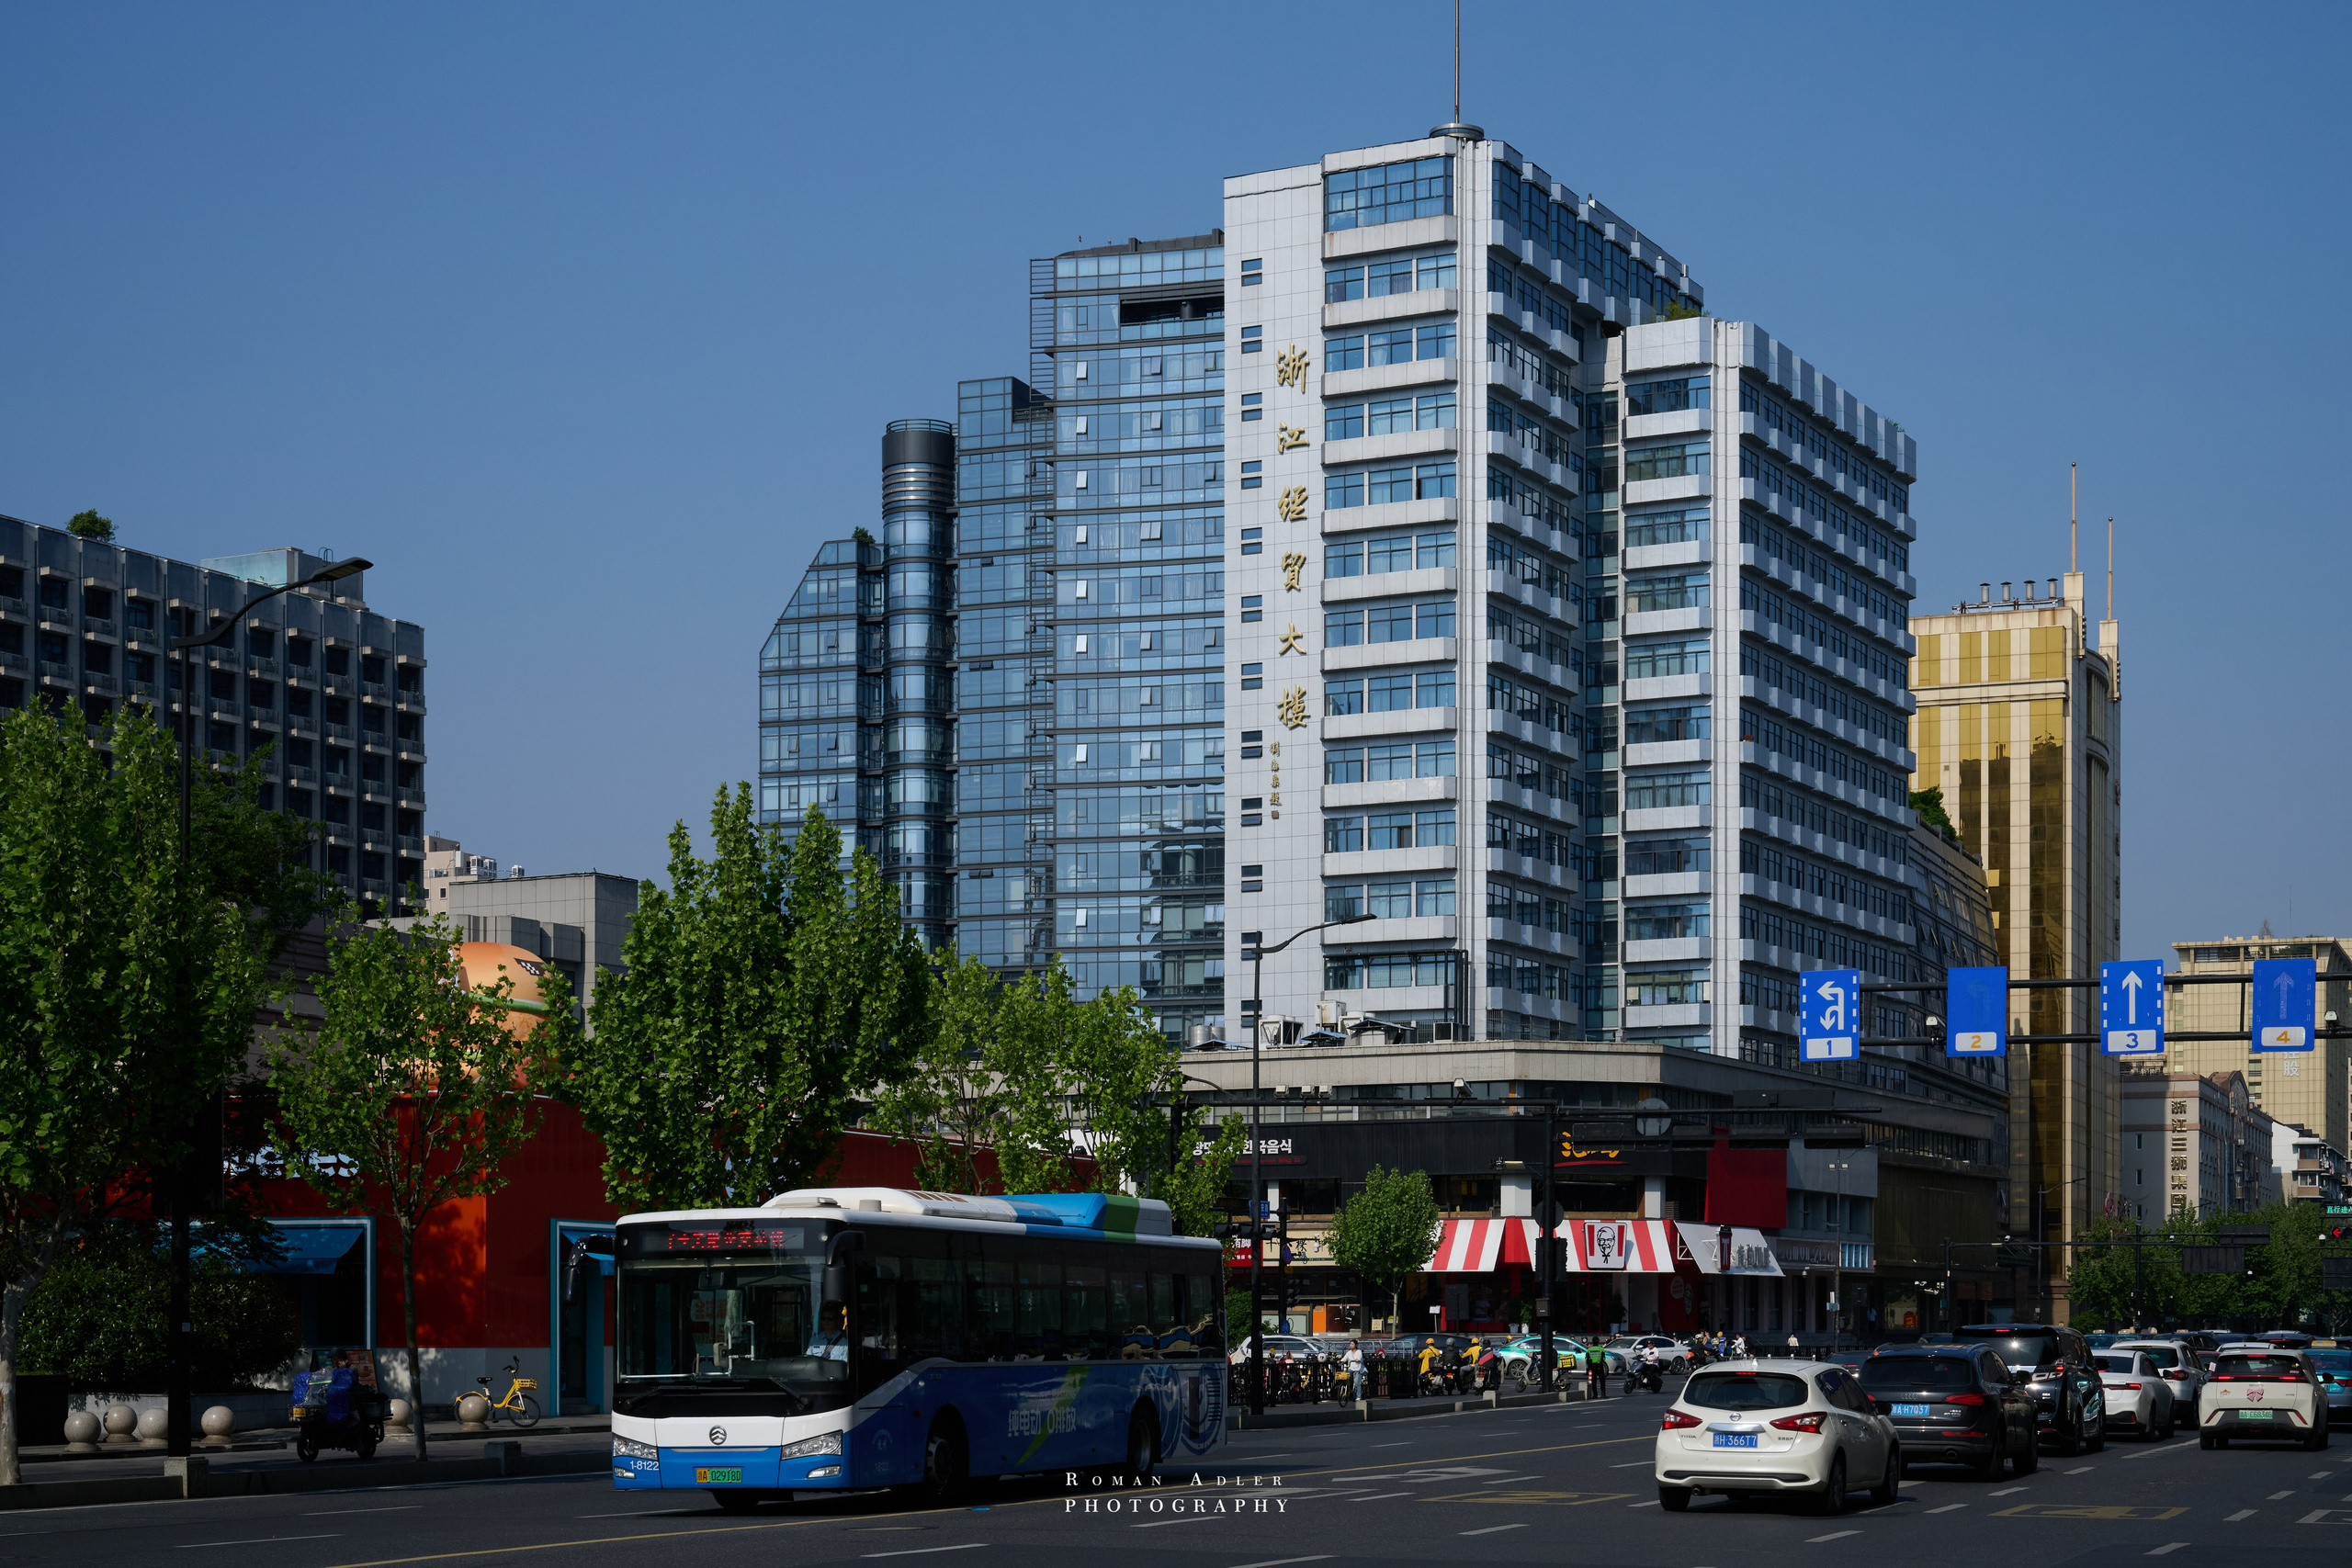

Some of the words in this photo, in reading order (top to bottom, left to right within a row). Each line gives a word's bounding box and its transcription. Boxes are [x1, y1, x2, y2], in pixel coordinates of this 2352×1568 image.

[1971, 1035, 1982, 1049] 2
[2125, 1032, 2139, 1049] 3
[2276, 1031, 2290, 1043] 4
[1826, 1040, 1833, 1056] 1
[1008, 1409, 1042, 1438] 纯电动
[629, 1461, 659, 1471] 1-8122
